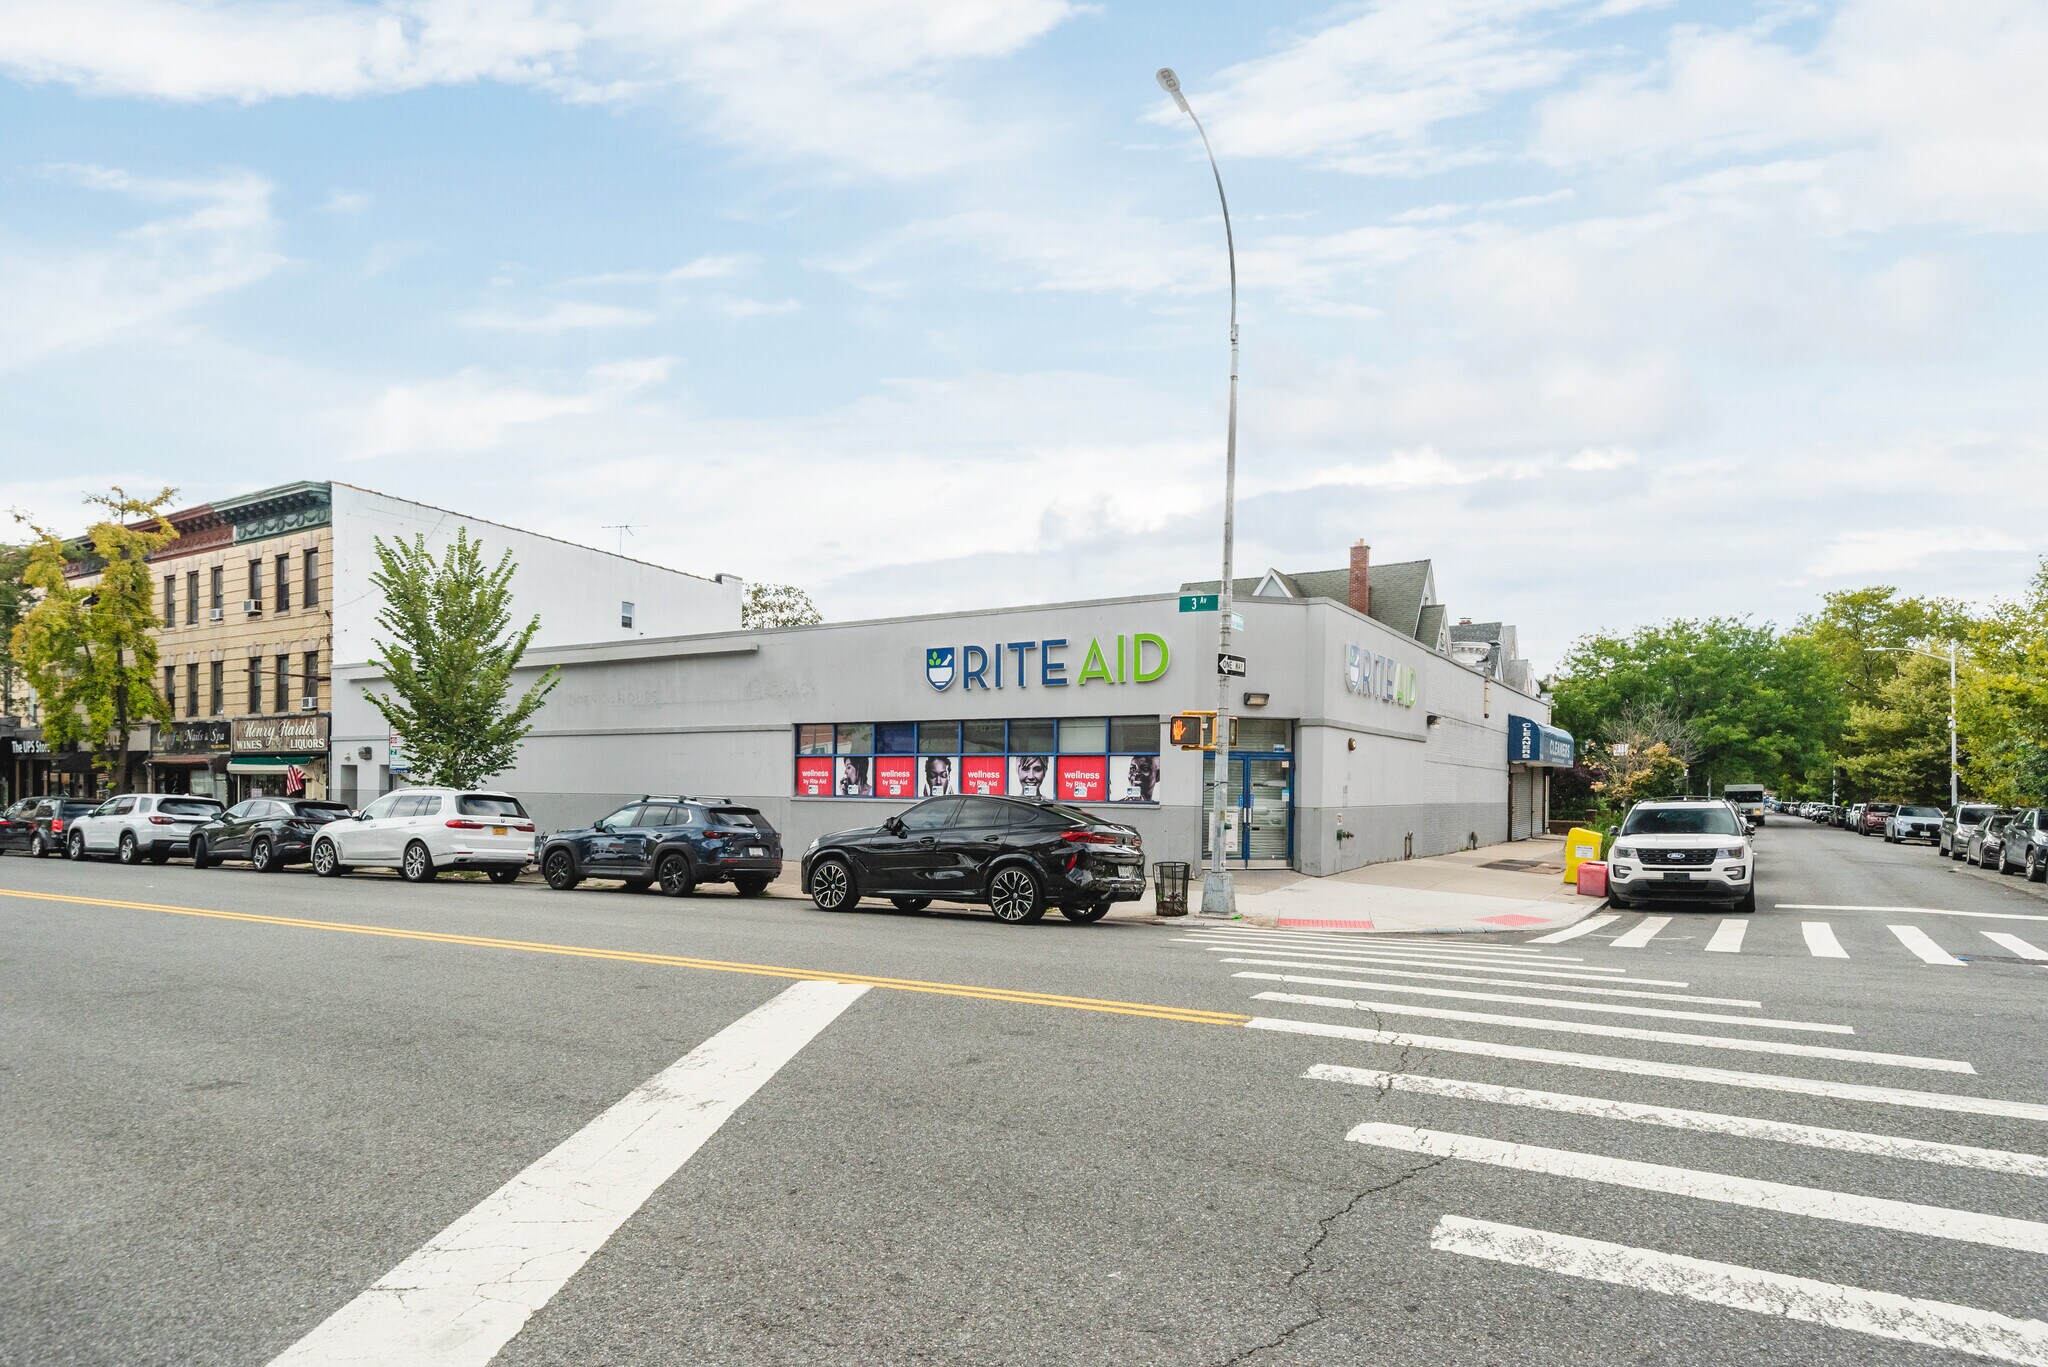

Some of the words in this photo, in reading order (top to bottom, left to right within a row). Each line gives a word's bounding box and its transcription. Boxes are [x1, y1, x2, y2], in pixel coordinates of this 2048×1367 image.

[1191, 597, 1197, 610] 3
[963, 638, 1068, 690] RITE
[1076, 632, 1170, 686] AID
[1222, 660, 1232, 669] ONE
[1235, 662, 1243, 670] WAY
[1361, 648, 1395, 701] RITE
[1394, 662, 1417, 707] AID
[184, 729, 203, 742] Nails
[210, 728, 224, 744] Spa
[243, 722, 275, 747] Henry
[1522, 723, 1531, 759] CLEANERS
[11, 741, 23, 753] The
[23, 740, 36, 753] UPS
[236, 740, 263, 750] WINES
[290, 738, 325, 750] LIQUORS
[1550, 740, 1570, 758] CLEANERS
[802, 769, 829, 777] wellness
[880, 769, 910, 778] wellness
[967, 770, 1000, 779] wellness
[1064, 770, 1100, 780] wellness
[1065, 780, 1074, 788] by
[1074, 780, 1086, 788] Rite
[1087, 780, 1097, 788] Aid
